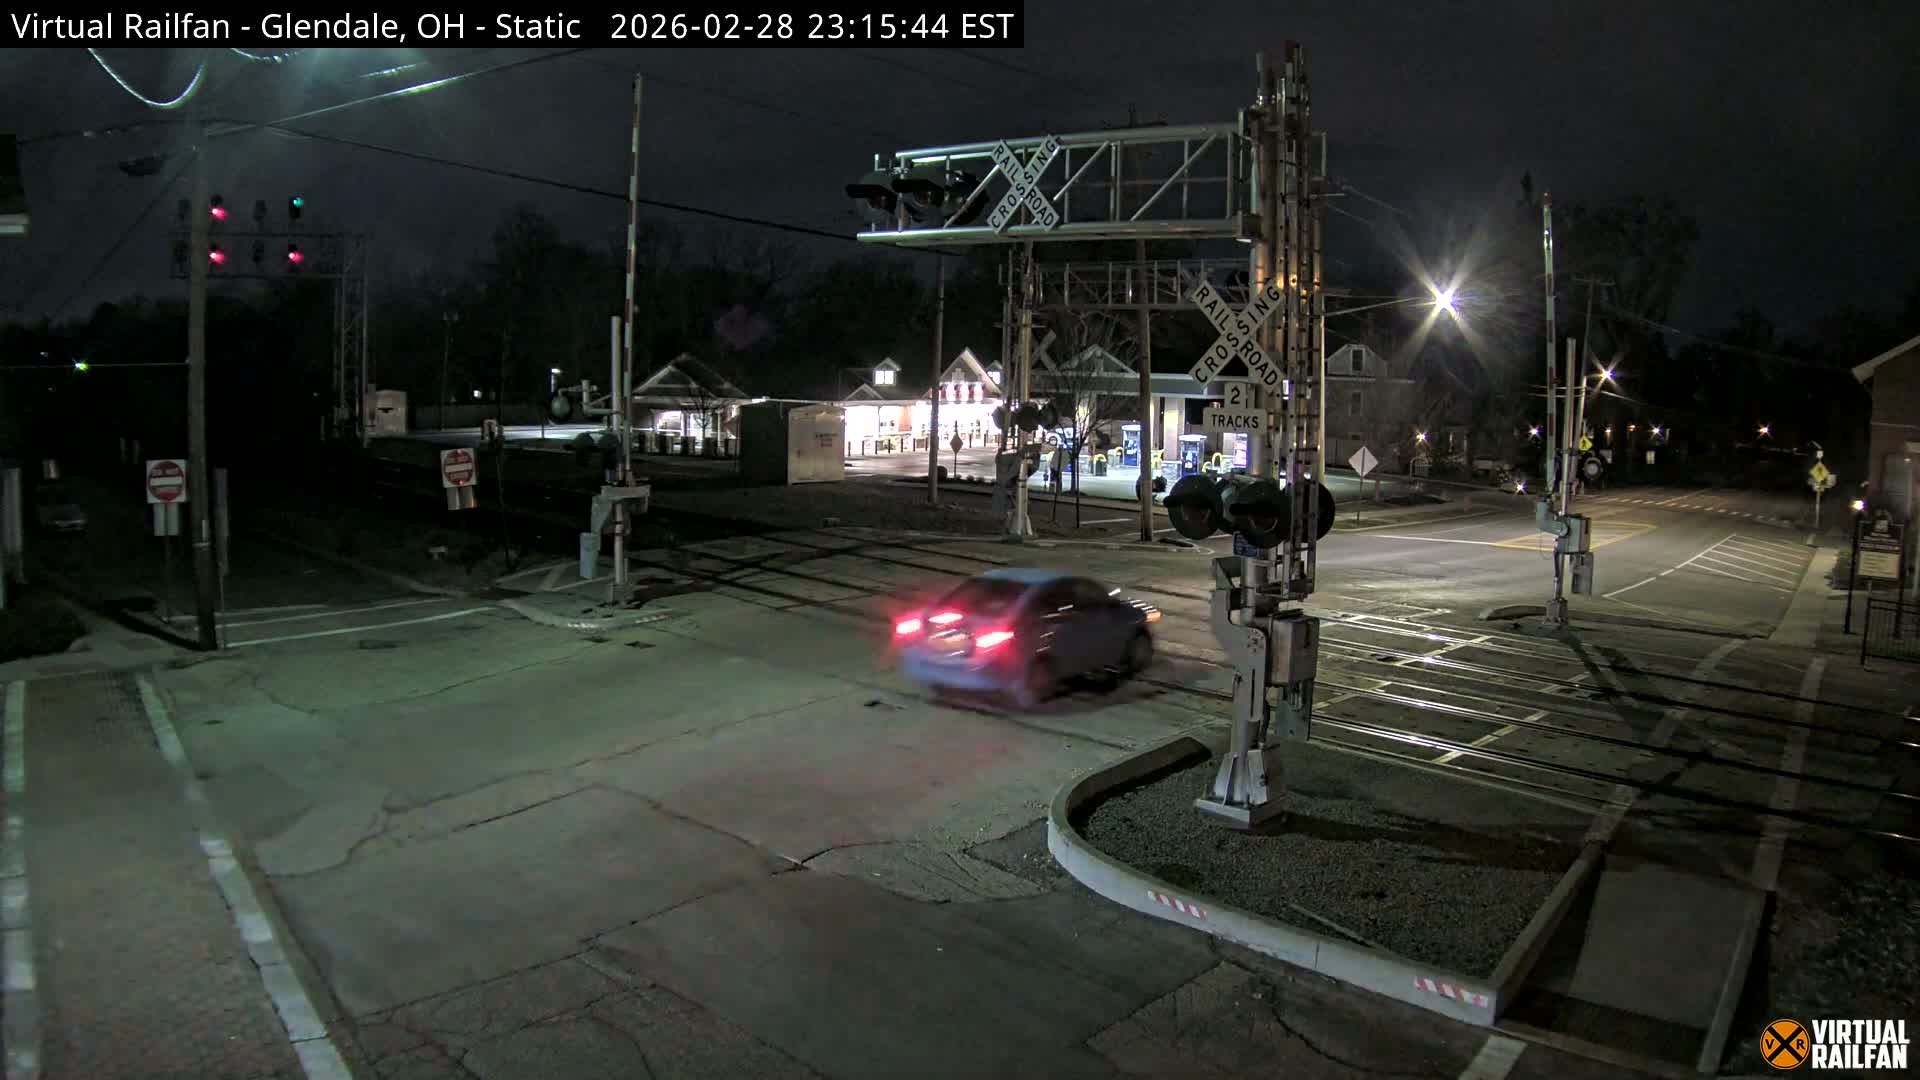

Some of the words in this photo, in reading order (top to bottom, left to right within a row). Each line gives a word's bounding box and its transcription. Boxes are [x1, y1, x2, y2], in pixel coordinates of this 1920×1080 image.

[991, 140, 1056, 229] CROSSING
[1195, 285, 1280, 383] CROSSING
[1211, 414, 1259, 429] TRACKS
[1230, 386, 1241, 405] 2
